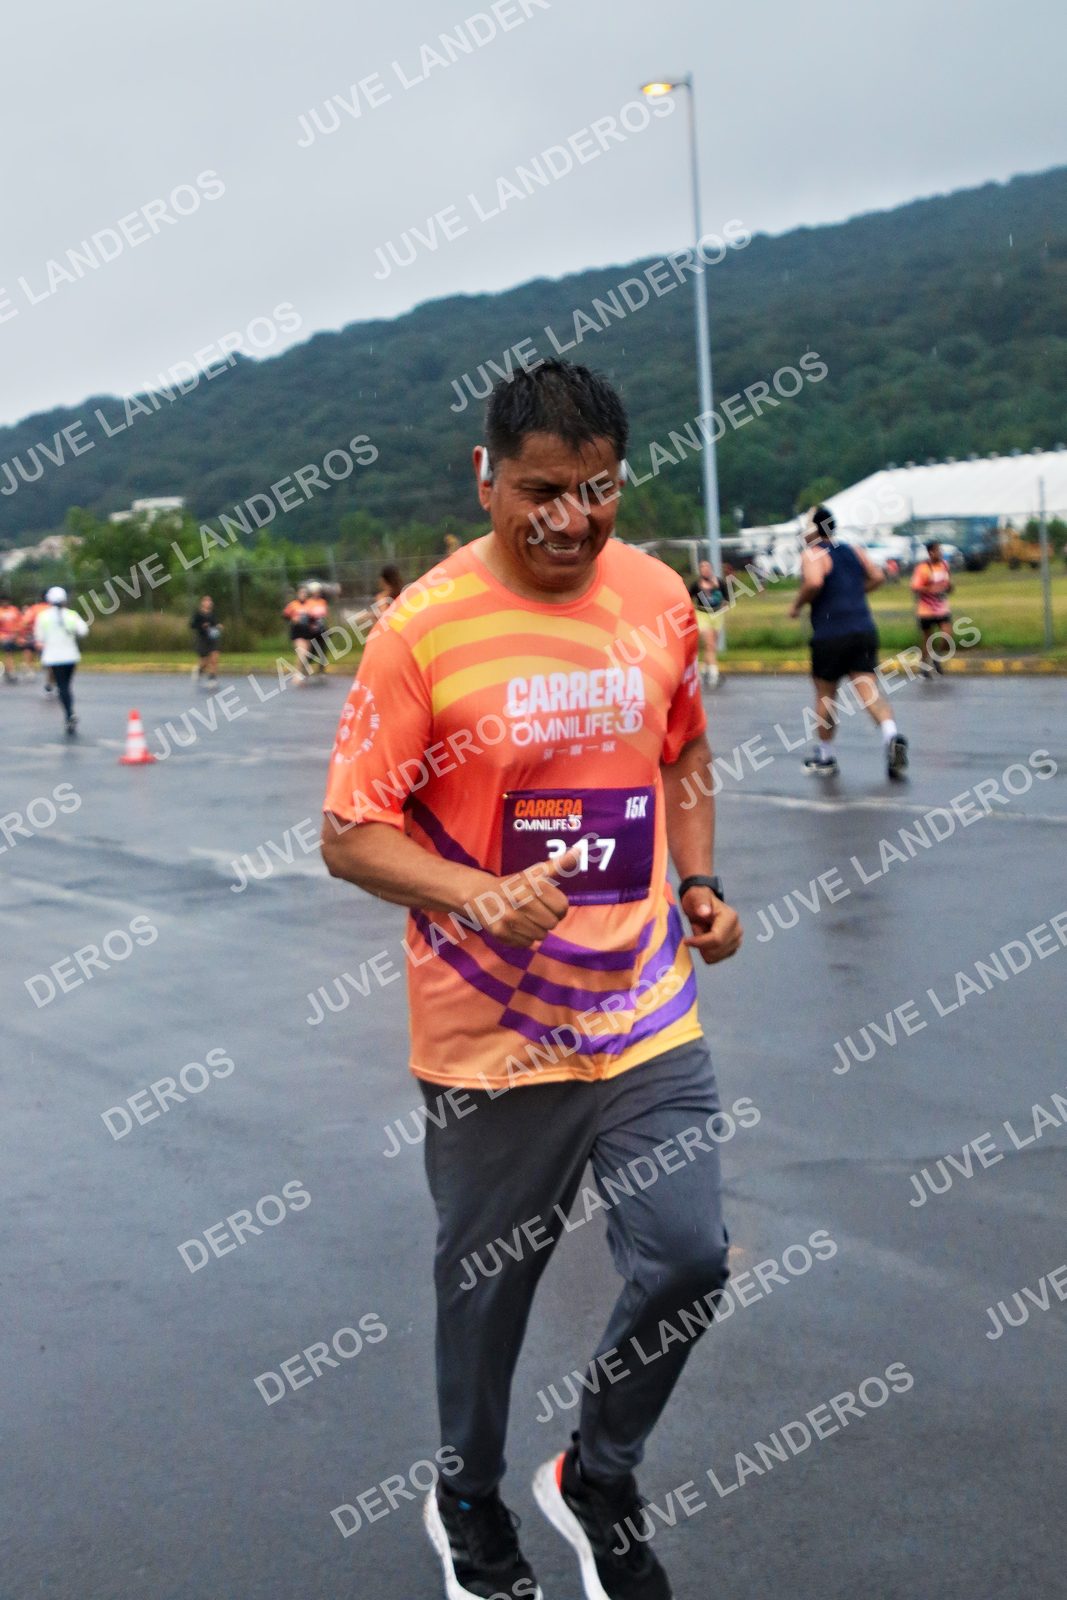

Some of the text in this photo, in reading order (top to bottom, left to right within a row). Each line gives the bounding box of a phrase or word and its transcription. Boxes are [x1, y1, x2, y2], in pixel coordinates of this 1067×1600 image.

[507, 666, 645, 717] CARRERA
[511, 711, 614, 747] OMNILIFE
[514, 799, 583, 818] CARRERA
[624, 795, 649, 820] 15K
[513, 817, 567, 832] OMNILIFE
